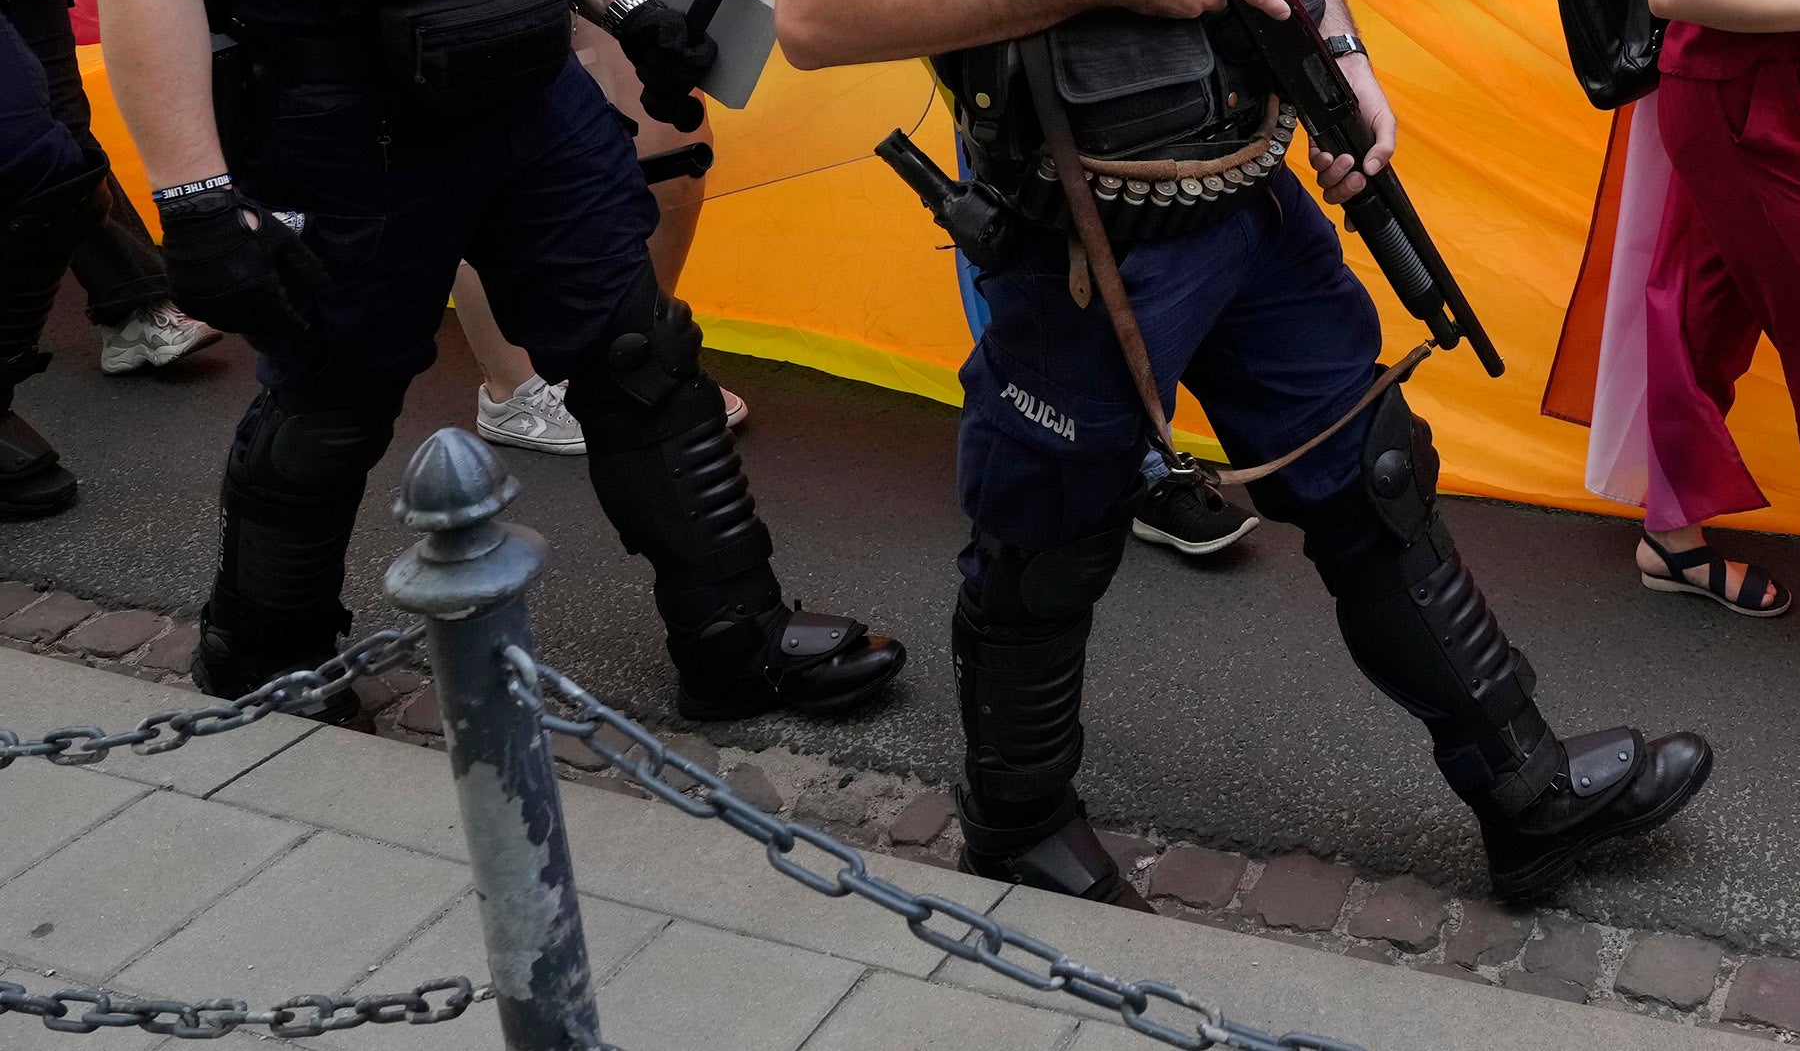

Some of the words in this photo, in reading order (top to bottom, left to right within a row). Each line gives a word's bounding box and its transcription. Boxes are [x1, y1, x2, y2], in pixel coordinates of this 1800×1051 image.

[184, 181, 205, 195] THE
[205, 174, 230, 189] HOLD
[162, 186, 183, 199] LINE
[1000, 382, 1075, 442] POLICJA
